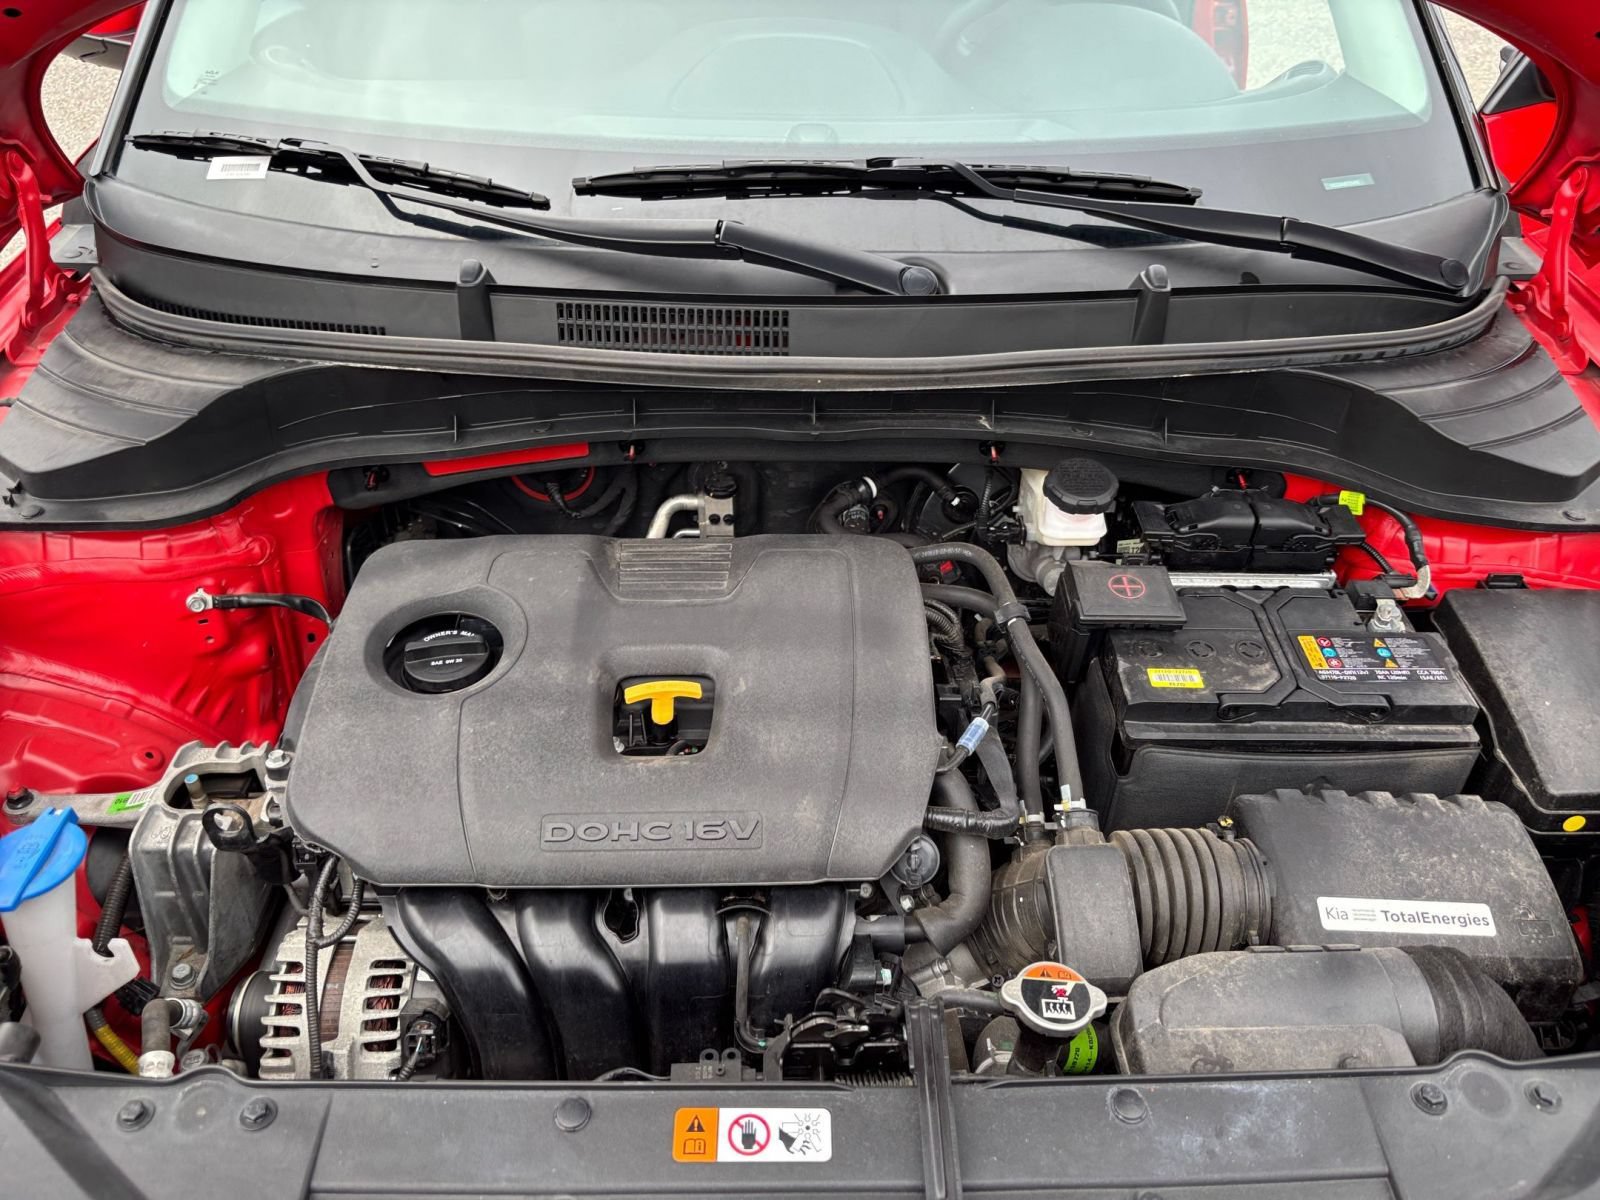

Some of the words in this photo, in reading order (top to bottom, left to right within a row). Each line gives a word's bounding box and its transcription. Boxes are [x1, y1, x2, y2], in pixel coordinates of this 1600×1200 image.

[423, 630, 458, 642] OWNER'S
[544, 821, 672, 842] DOHC
[684, 820, 760, 841] 16V
[1325, 907, 1349, 921] Kia
[1380, 909, 1490, 928] TotalEnergies
